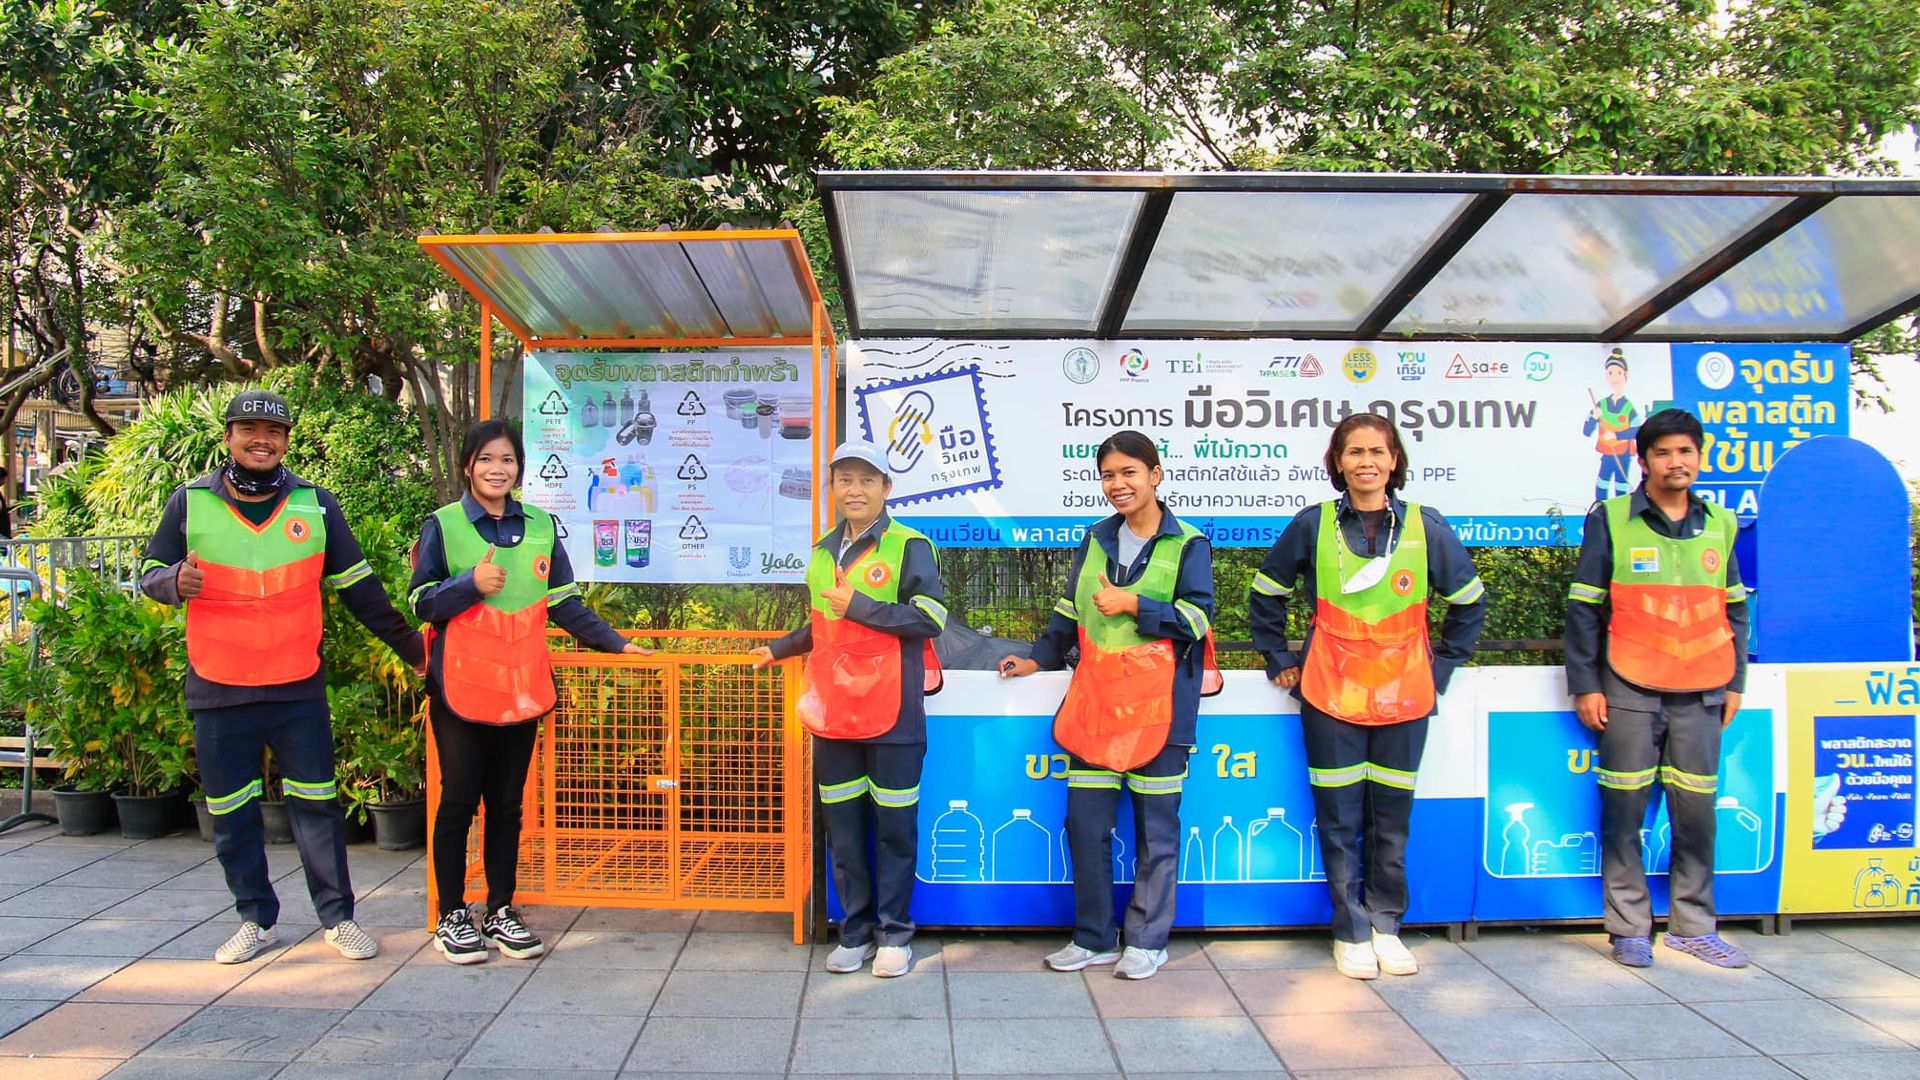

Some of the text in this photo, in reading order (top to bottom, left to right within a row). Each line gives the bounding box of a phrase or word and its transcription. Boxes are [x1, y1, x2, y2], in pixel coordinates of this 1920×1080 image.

[1269, 356, 1301, 369] FTI
[1347, 352, 1371, 362] LESS
[1397, 352, 1426, 363] YOU
[555, 357, 799, 389] จุดรับพลาสติกกำพร้า
[1740, 350, 1834, 393] จุดรับ
[242, 400, 286, 417] CFME
[1062, 403, 1174, 427] โครงการ
[1699, 394, 1836, 424] พลาสติก
[939, 425, 976, 450] มือ
[1194, 433, 1288, 458] พี่ไม้กวาด
[942, 449, 979, 464] วิเศษ
[931, 465, 981, 483] กรุงเทพ
[1424, 467, 1456, 481] PPE
[1063, 490, 1109, 507] ช่วยพ
[1695, 489, 1759, 514] PLA
[1012, 524, 1086, 542] พลาสติ
[1212, 743, 1257, 778] ใส
